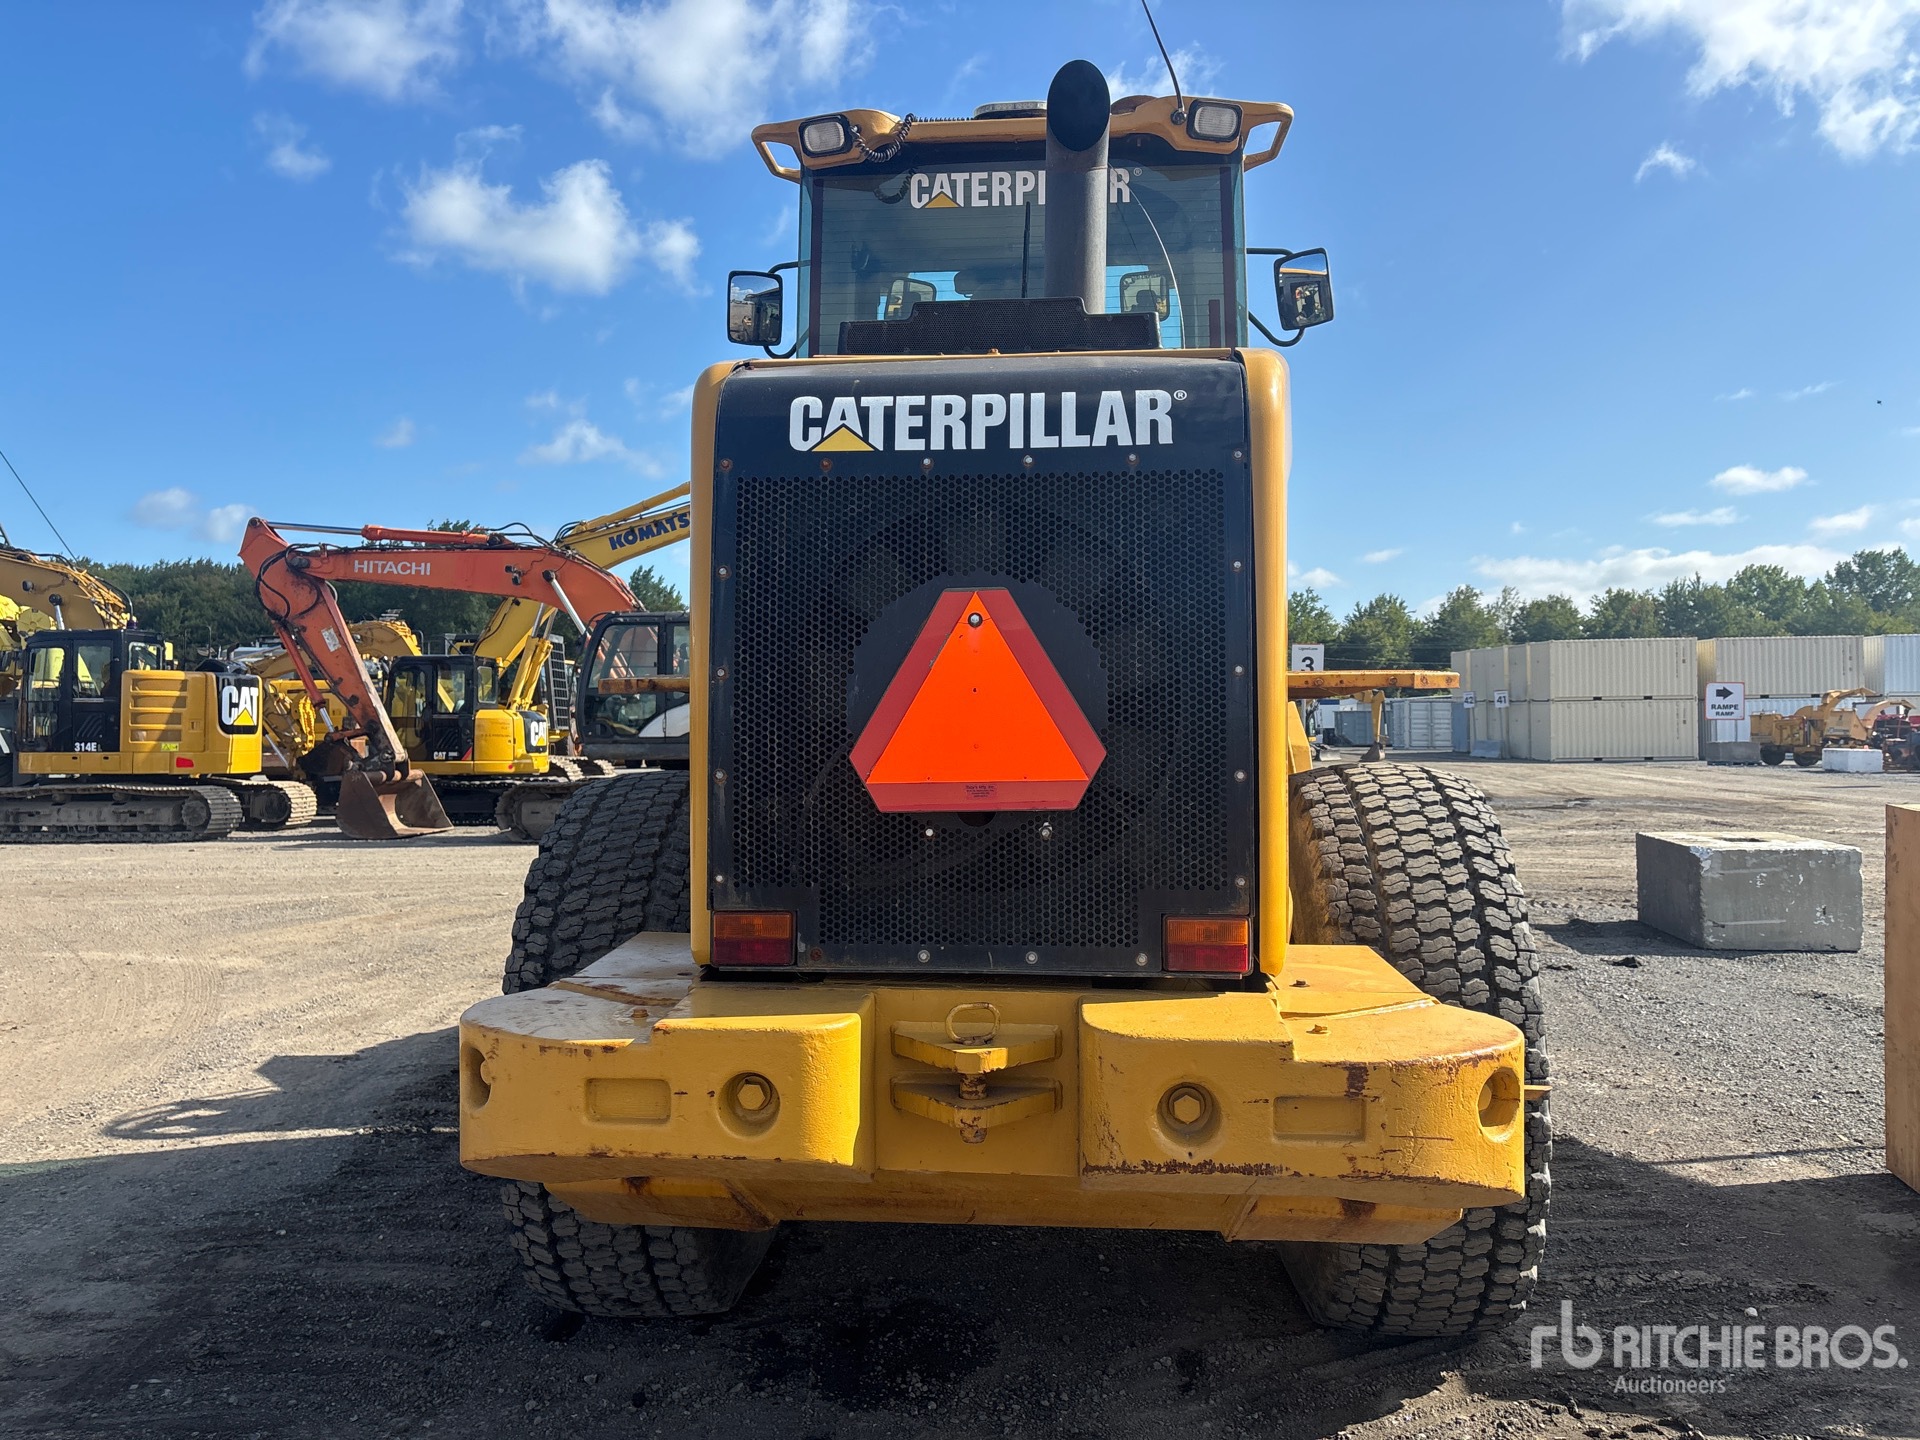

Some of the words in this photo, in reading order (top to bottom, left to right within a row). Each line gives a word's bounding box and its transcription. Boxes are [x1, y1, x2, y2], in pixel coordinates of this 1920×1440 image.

[608, 511, 690, 551] KOMATS
[353, 559, 431, 576] HITACHI
[1300, 656, 1315, 671] 3
[221, 685, 259, 726] CAT
[1464, 696, 1473, 704] 42
[1496, 695, 1507, 704] 41
[530, 721, 546, 746] CAT
[74, 742, 97, 752] 314E
[433, 751, 447, 760] CAT
